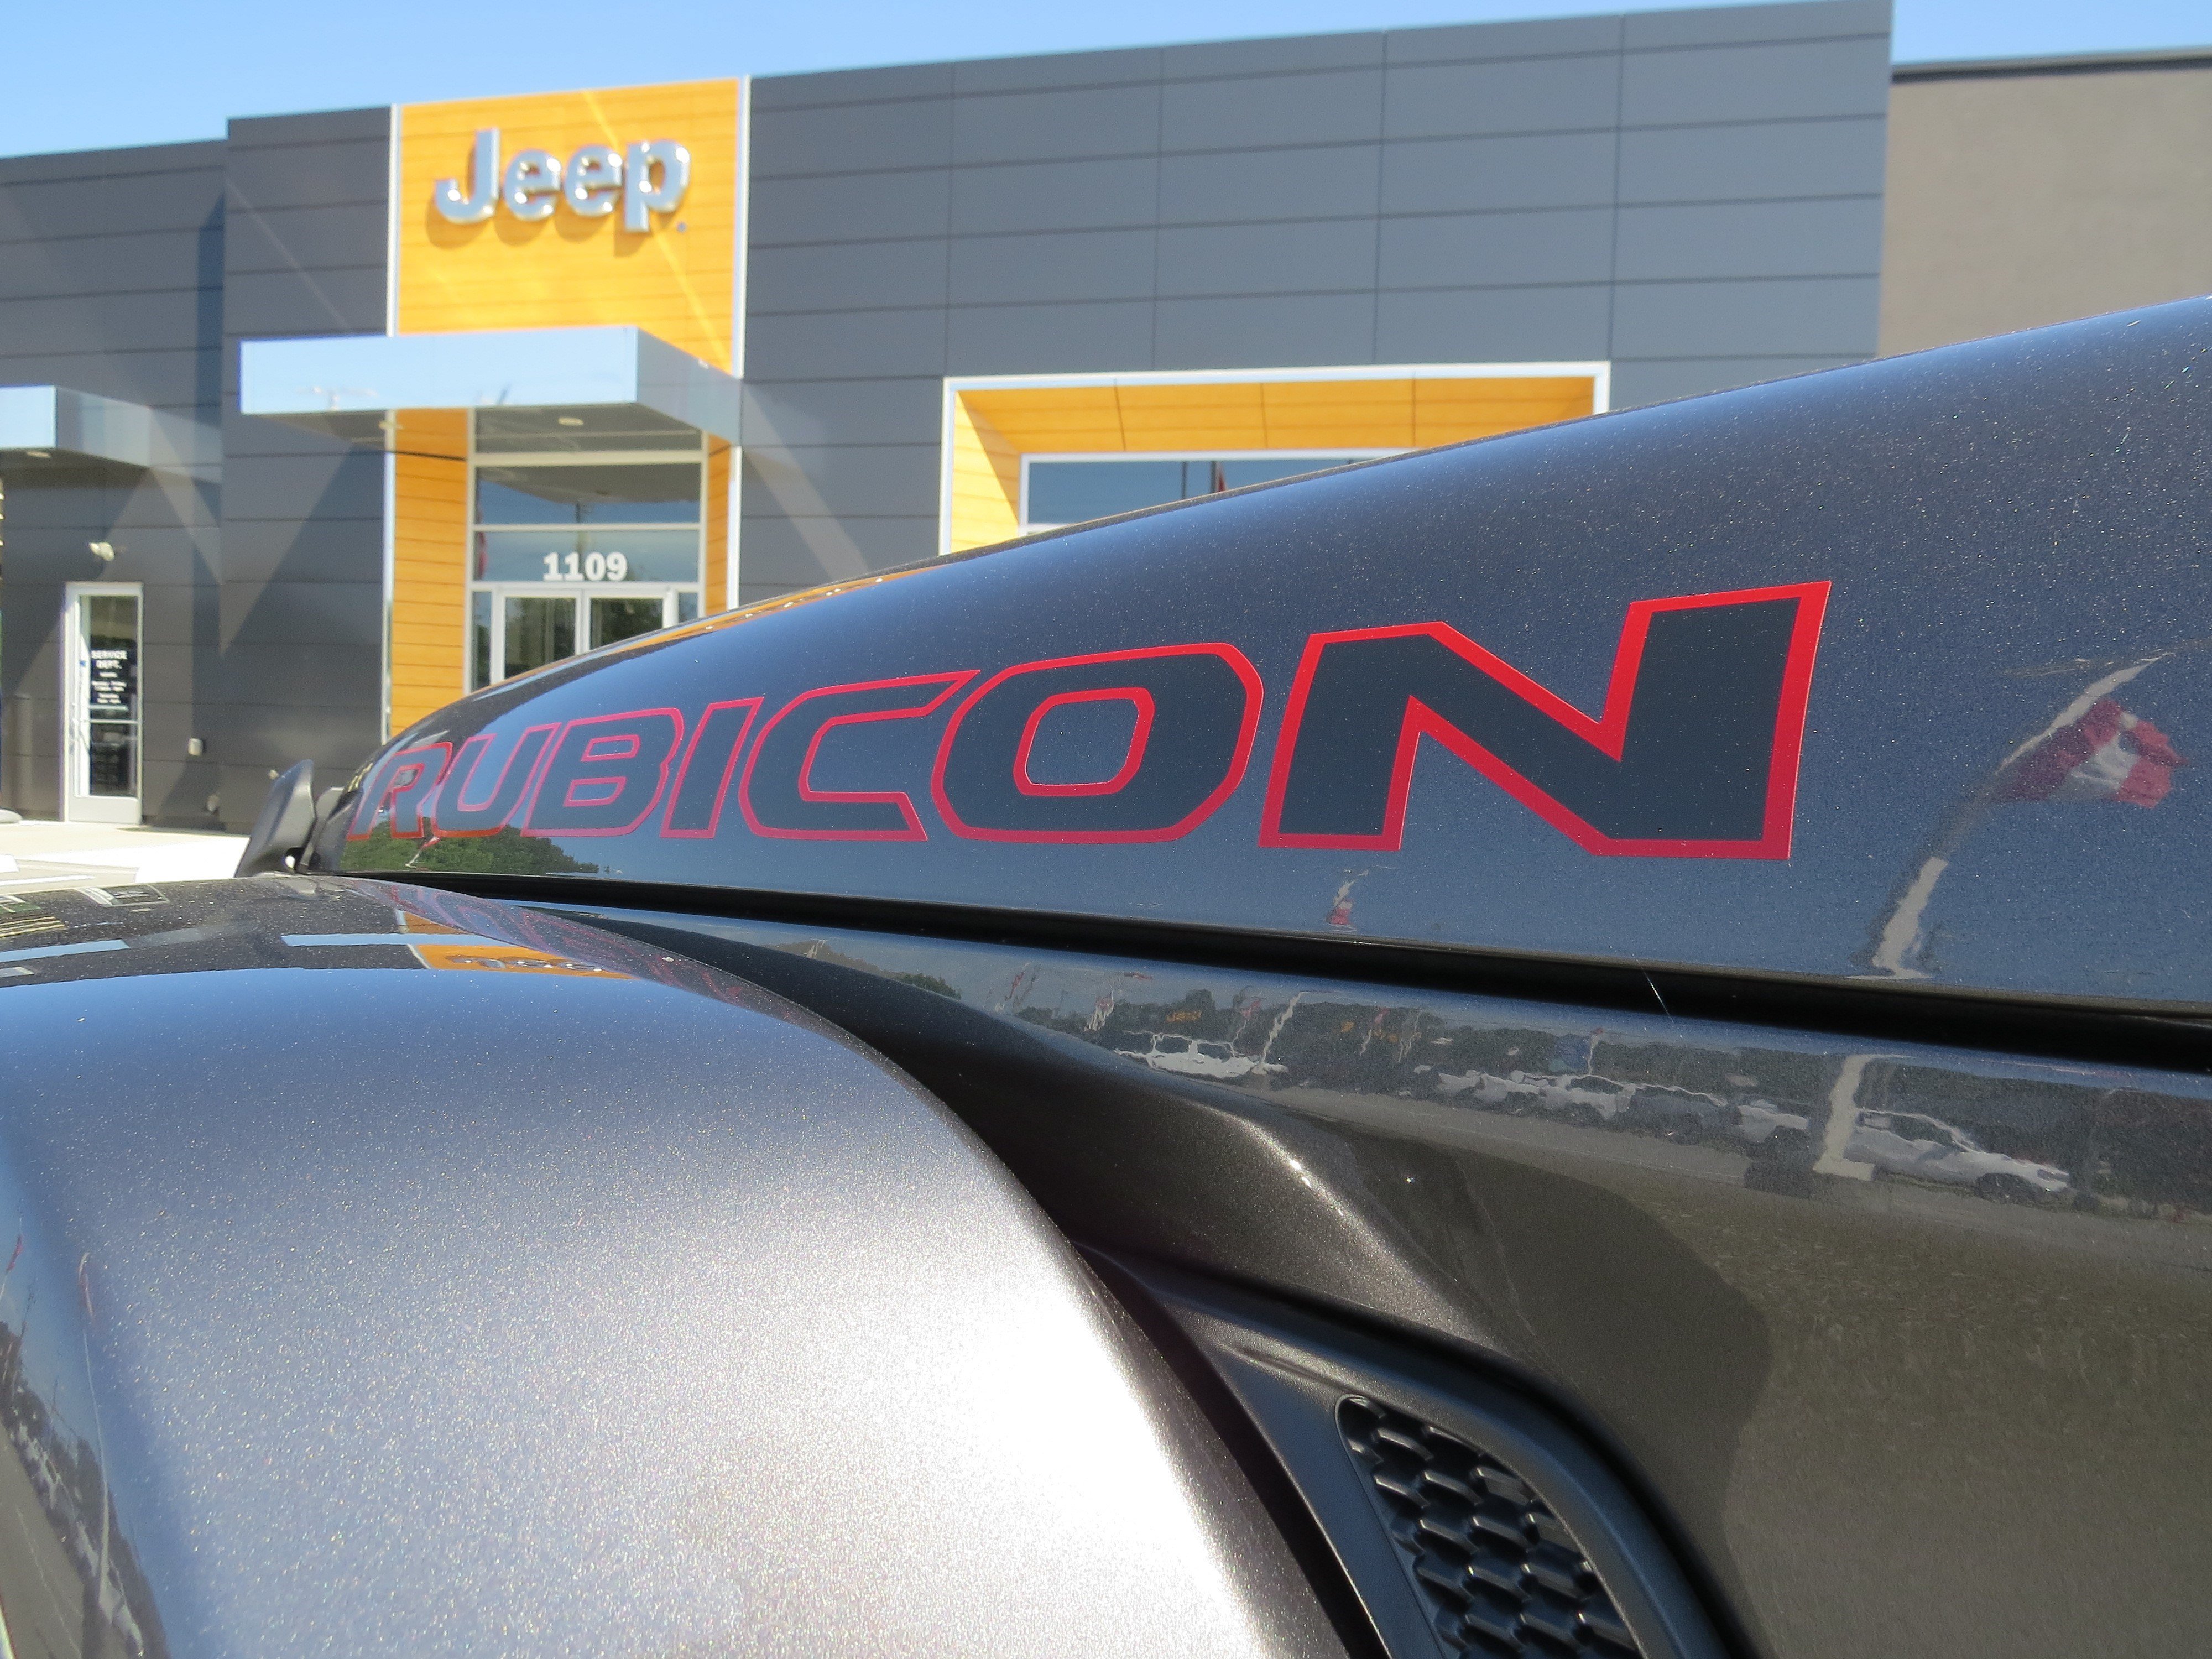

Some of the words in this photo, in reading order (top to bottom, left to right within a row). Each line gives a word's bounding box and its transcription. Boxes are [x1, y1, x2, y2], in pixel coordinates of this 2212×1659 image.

[434, 127, 691, 233] Jeep
[542, 551, 628, 581] 1109
[347, 581, 1832, 860] RUBICON
